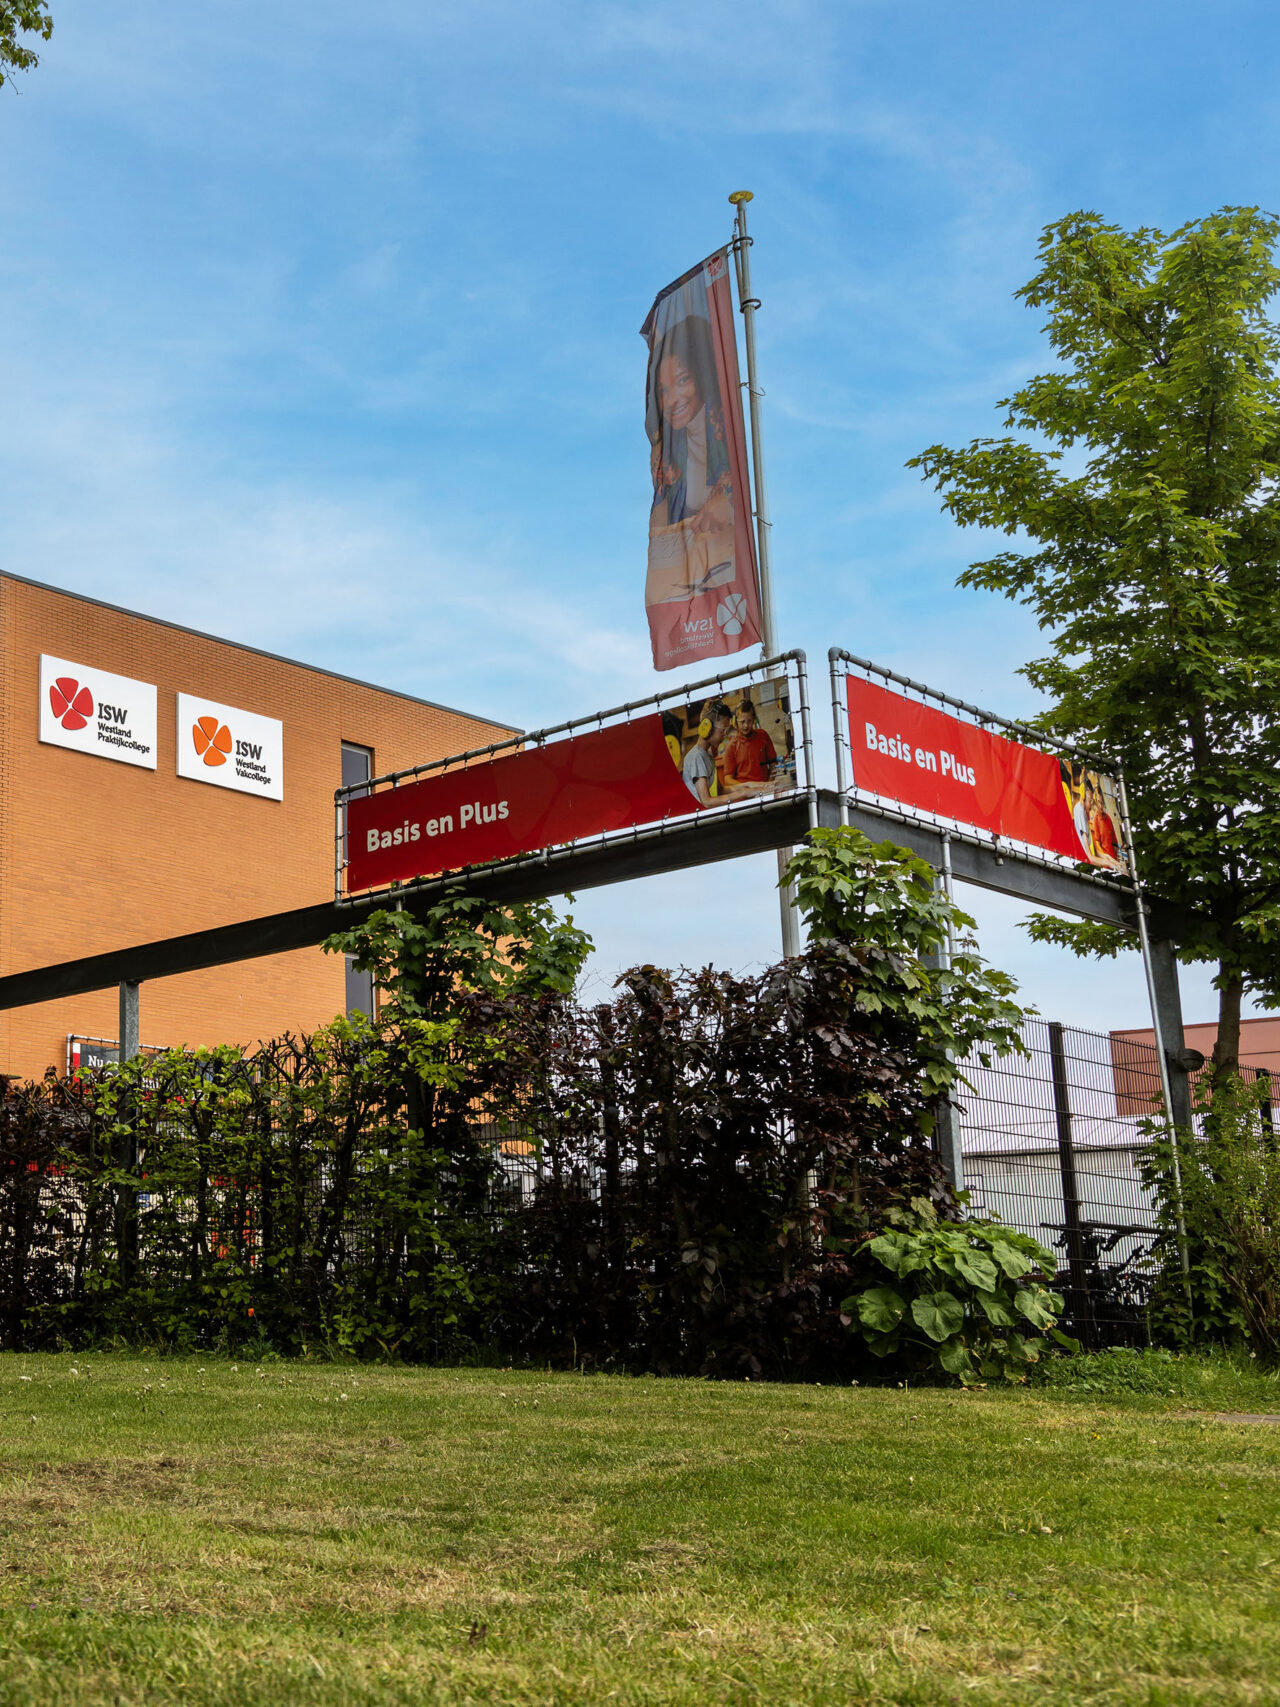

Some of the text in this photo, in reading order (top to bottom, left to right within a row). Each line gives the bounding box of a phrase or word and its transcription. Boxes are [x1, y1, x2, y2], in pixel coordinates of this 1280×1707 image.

[98, 702, 128, 725] ISW
[97, 721, 132, 738] Westland
[97, 732, 150, 754] Praktijkcollege
[236, 739, 263, 760] ISW
[865, 722, 976, 786] Basis en Plus
[235, 758, 267, 773] Westland
[235, 767, 272, 785] Vakcollege
[367, 801, 510, 852] Basis en Plus
[87, 1054, 104, 1068] Nu
